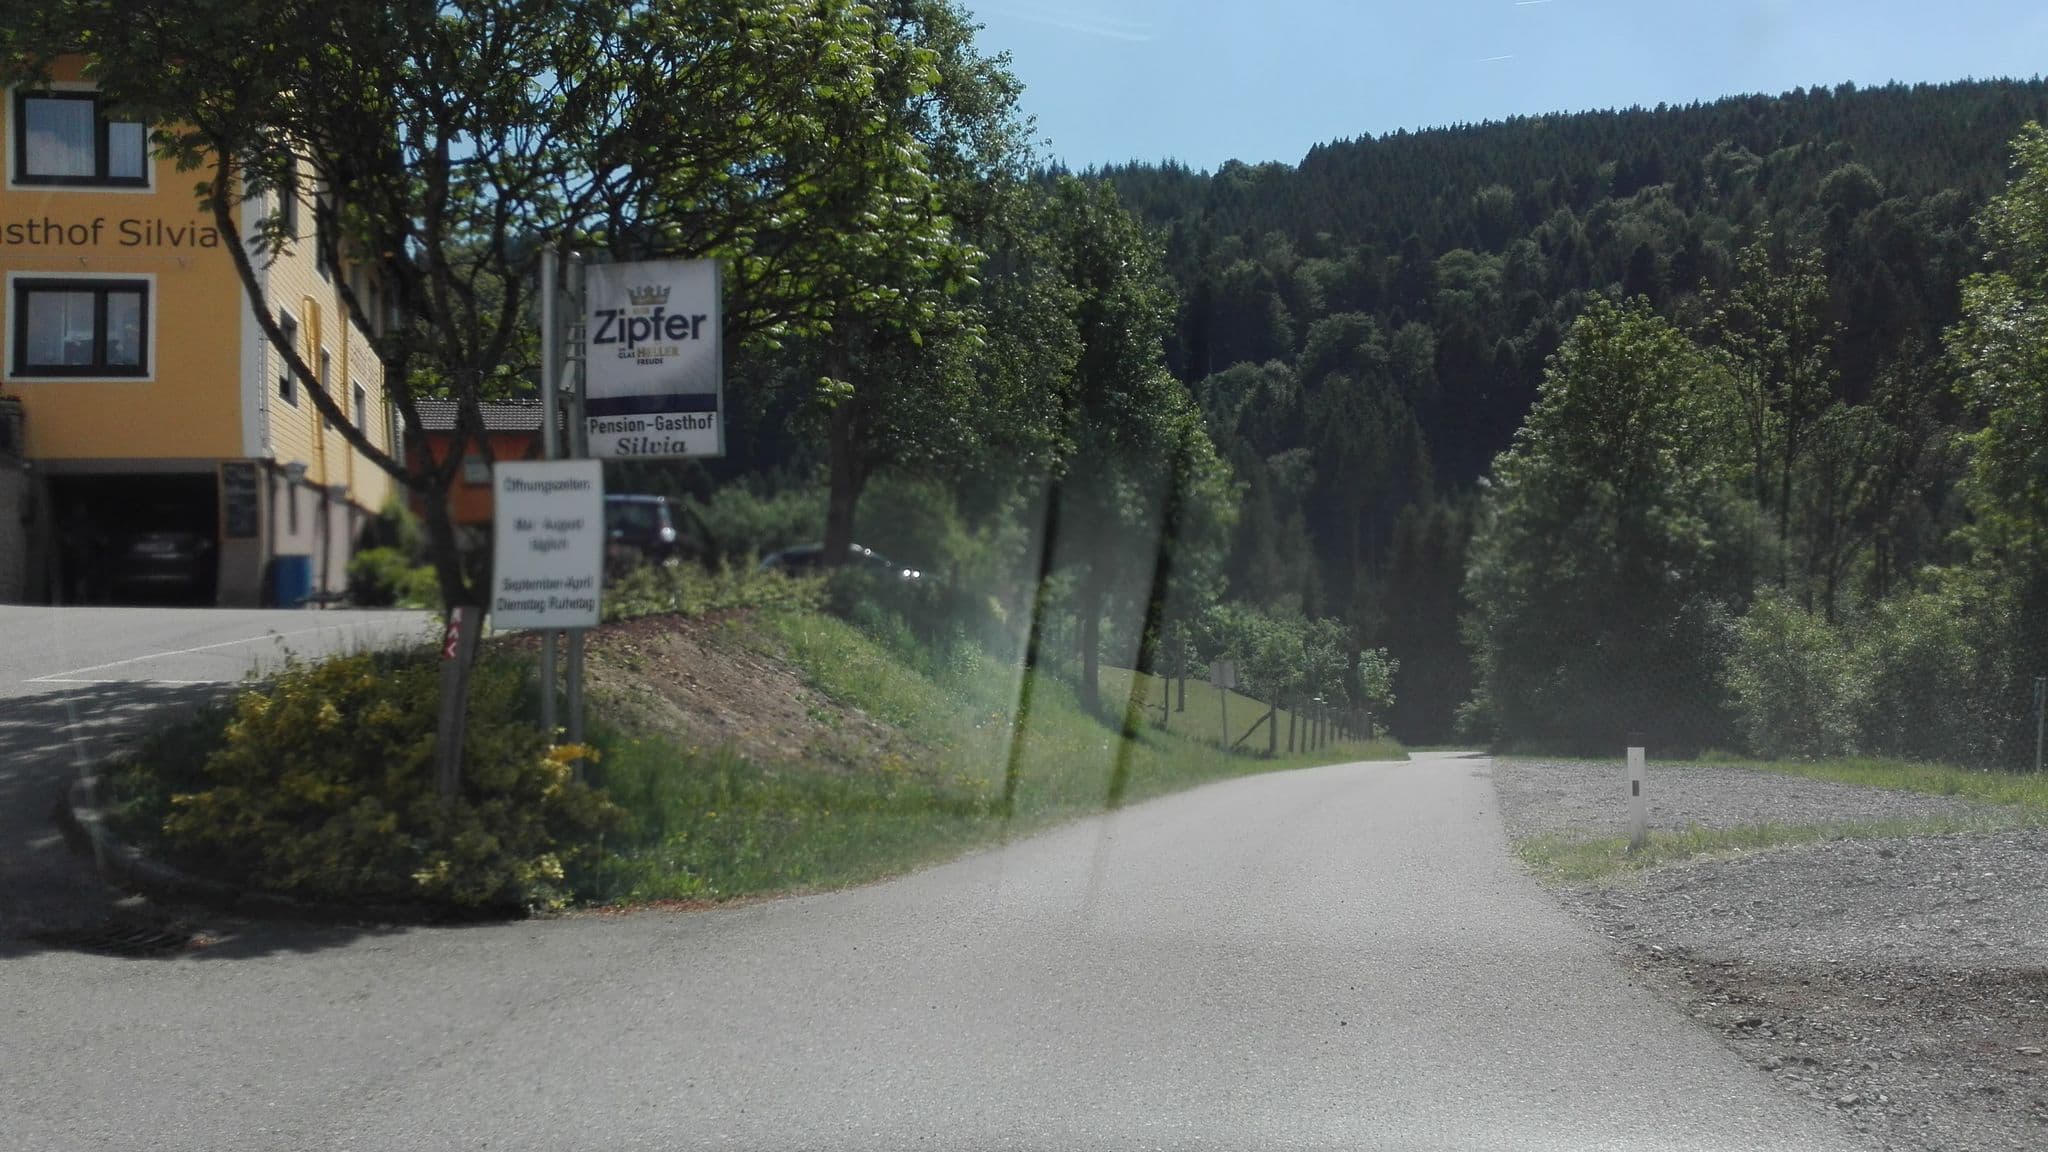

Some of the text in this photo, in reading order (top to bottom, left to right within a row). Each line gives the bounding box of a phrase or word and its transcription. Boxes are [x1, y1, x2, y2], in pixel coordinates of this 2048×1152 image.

[0, 217, 219, 248] sthof Silvia
[593, 306, 707, 349] Zipfer
[590, 414, 713, 434] Pension-Gasthof
[616, 436, 688, 456] Silvia
